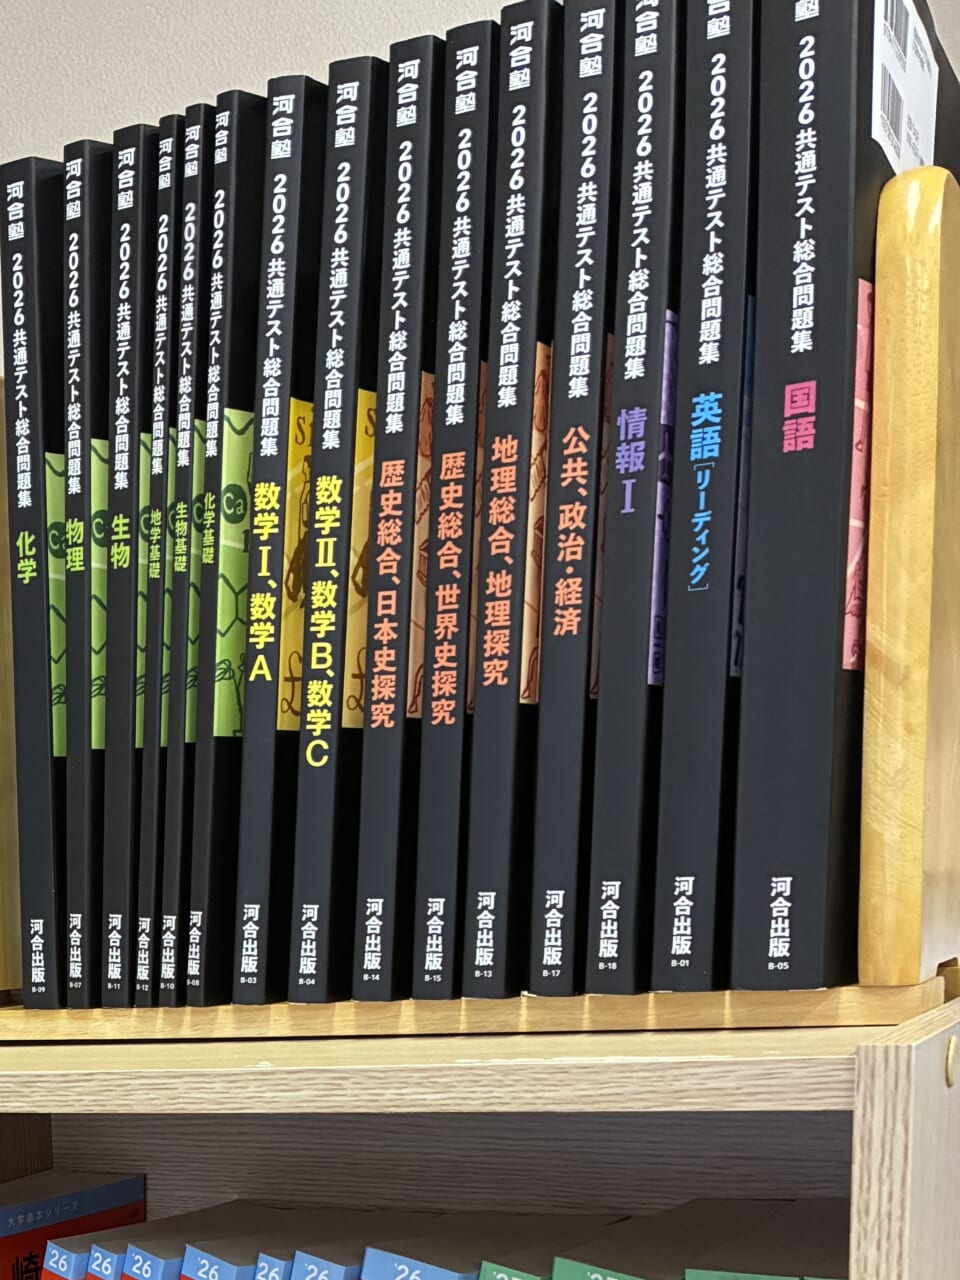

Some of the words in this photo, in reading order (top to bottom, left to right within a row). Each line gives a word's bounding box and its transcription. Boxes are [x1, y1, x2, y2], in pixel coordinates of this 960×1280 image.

[508, 21, 534, 92] 河合塾
[579, 8, 606, 78] 河合塾
[271, 94, 295, 159] 河合塾
[396, 58, 421, 128] 河合塾
[184, 124, 201, 177] 河合塾
[782, 380, 817, 453] 国語
[66, 518, 85, 572] 物理
[111, 514, 130, 569] 生物
[149, 509, 162, 579] 地学基礎
[174, 502, 187, 573] 生物基礎
[201, 492, 216, 564] 化学基礎
[6, 180, 25, 240] 河合塾
[16, 531, 37, 585] 化学
[30, 918, 45, 983] 河合出版
[108, 914, 123, 980] 河合出版
[241, 904, 261, 974] 河合出版
[475, 891, 496, 966] 河合出版
[671, 876, 695, 956] 河合出版
[768, 876, 793, 958] 河合出版
